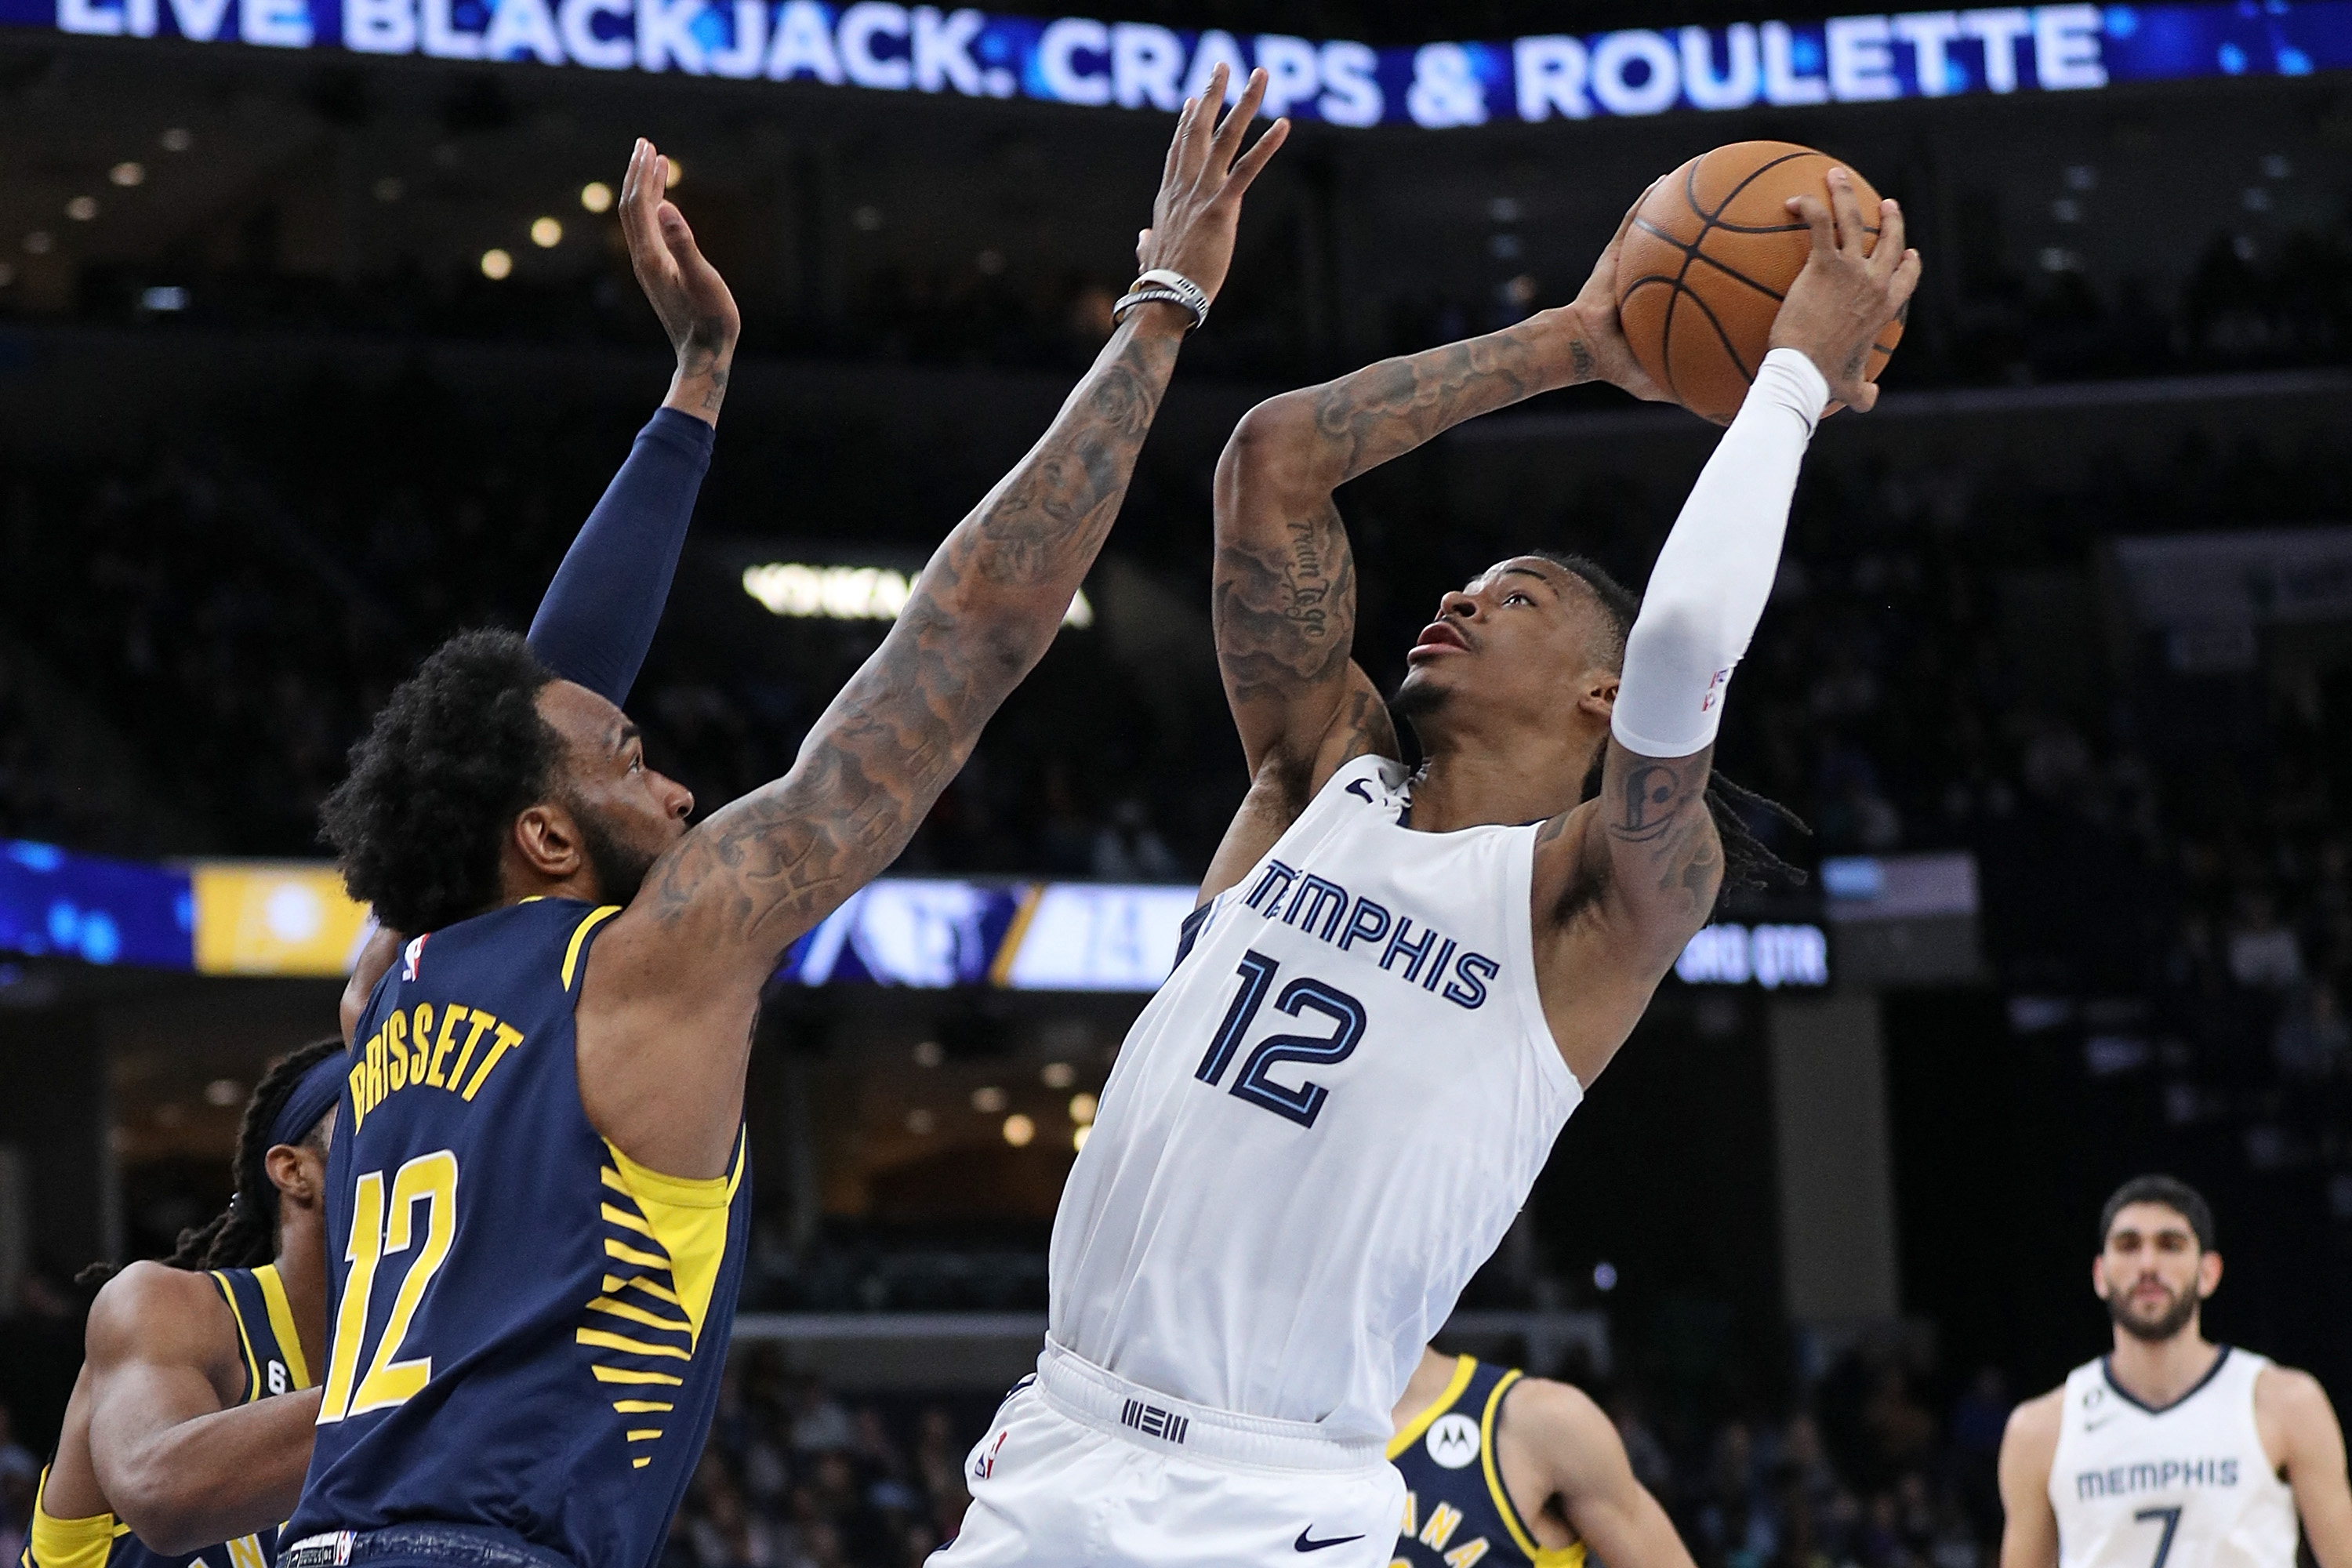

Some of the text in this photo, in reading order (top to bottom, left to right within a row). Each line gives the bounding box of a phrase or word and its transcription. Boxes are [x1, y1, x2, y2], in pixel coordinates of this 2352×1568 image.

[1038, 17, 1384, 129] CRAPS
[1406, 41, 1488, 129] &
[1512, 2, 2108, 123] ROULETTE
[1241, 858, 1501, 1010] MMPHIS
[349, 1003, 524, 1136] BRISSETT
[1194, 948, 1367, 1129] 12
[314, 1149, 459, 1425] 12
[267, 1359, 286, 1395] 6
[2076, 1459, 2239, 1502] MEMPHIS
[2133, 1504, 2183, 1568] 7
